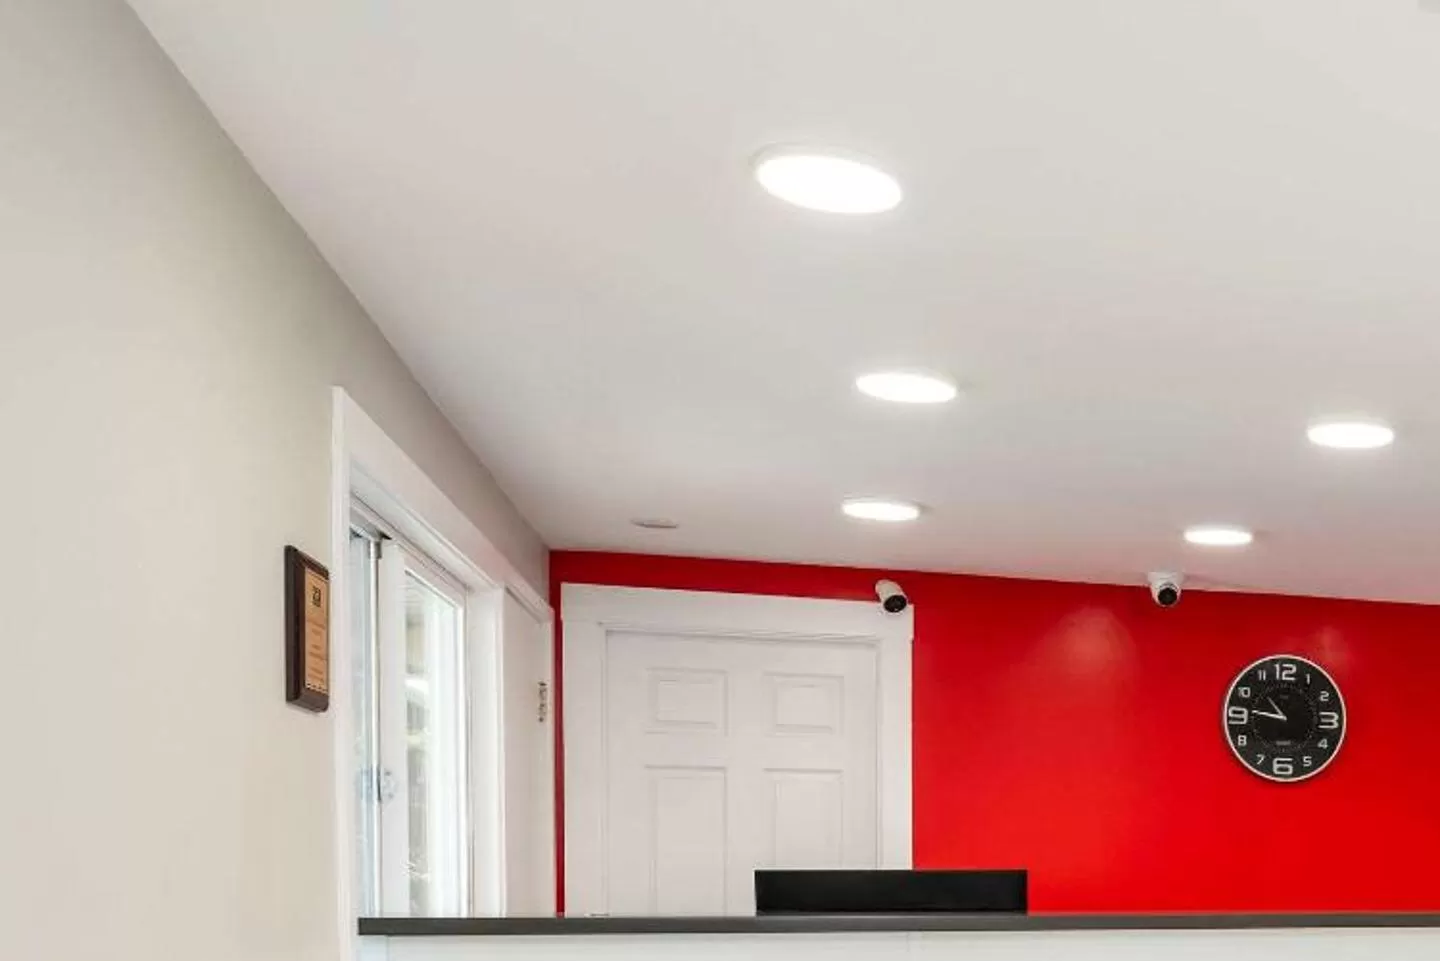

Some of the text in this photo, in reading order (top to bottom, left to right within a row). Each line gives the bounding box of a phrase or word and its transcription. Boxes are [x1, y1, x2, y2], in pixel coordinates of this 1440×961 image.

[1257, 669, 1266, 681] 11
[1274, 664, 1297, 681] 12
[1305, 673, 1311, 685] 1
[1238, 686, 1251, 698] 10
[1319, 690, 1330, 702] 2
[1228, 706, 1249, 725] 9
[1318, 711, 1339, 729] 3
[1237, 734, 1247, 747] 8
[1317, 738, 1328, 749] 4
[1256, 754, 1265, 765] 7
[1303, 755, 1312, 767] 5
[1272, 757, 1294, 775] 6
